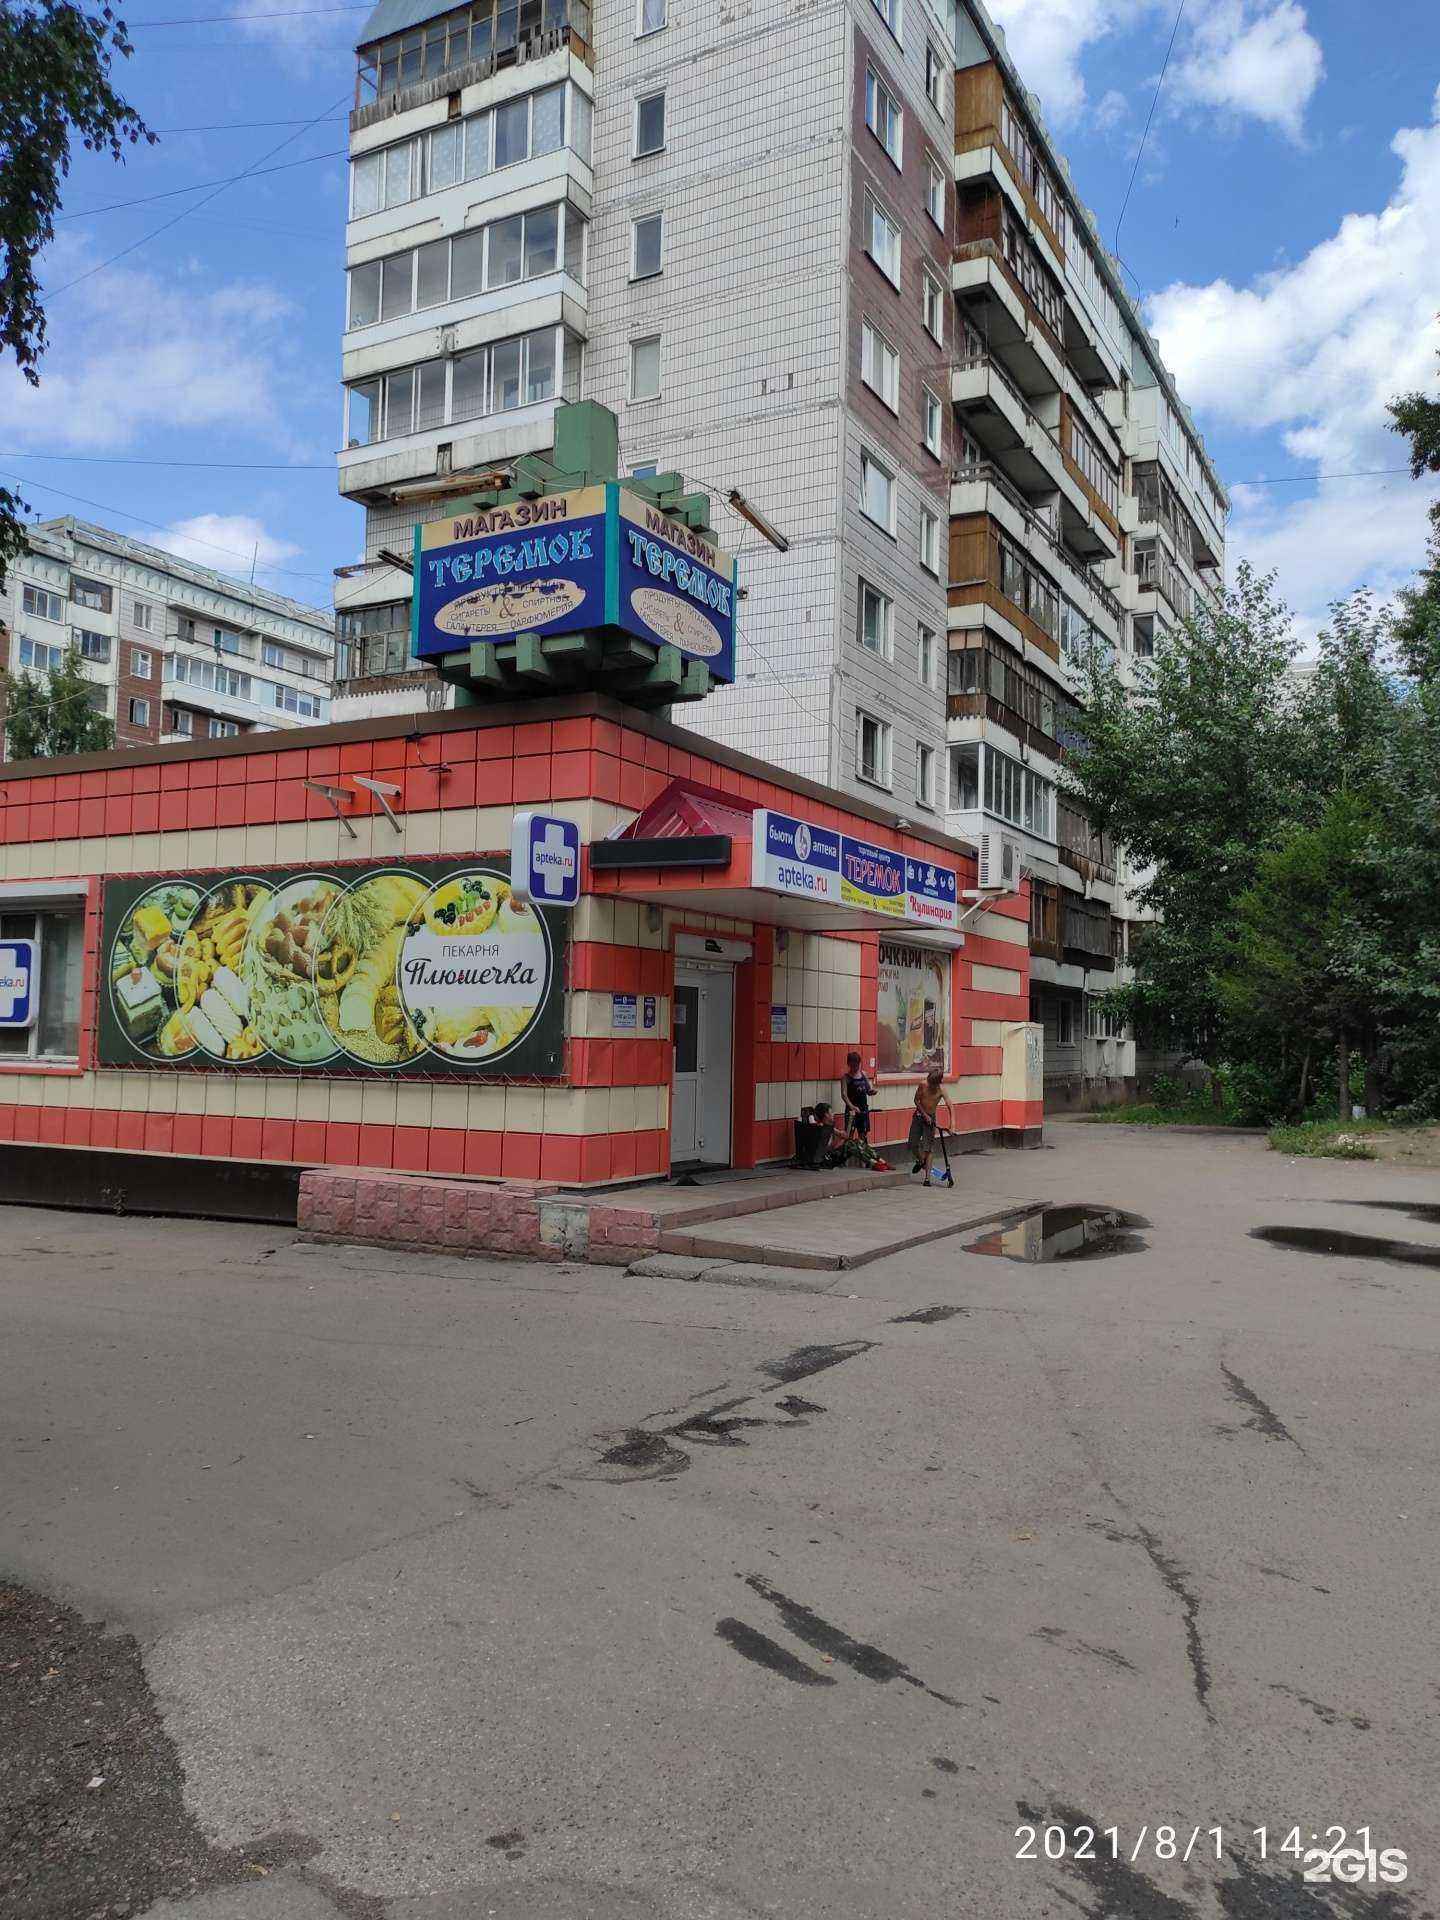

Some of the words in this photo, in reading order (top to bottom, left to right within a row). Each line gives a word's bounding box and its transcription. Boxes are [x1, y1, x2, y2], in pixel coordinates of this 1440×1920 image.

[453, 499, 567, 539] МАГАЗИН
[645, 508, 716, 566] МАГАЗИН
[429, 527, 594, 588] ТЕРЕМОК
[628, 529, 731, 618] ТЕРЕМОК
[450, 607, 491, 621] СИГАРЕТЫ
[769, 825, 793, 845] бьюти
[812, 842, 837, 857] аптека
[535, 852, 573, 866] apteka.ru
[845, 853, 902, 893] ТЕРЕМОК
[778, 864, 828, 895] apteka.ru
[909, 895, 953, 922] Кулинария
[442, 944, 500, 957] ПЕКАРНЯ
[404, 958, 538, 985] Плюшечка
